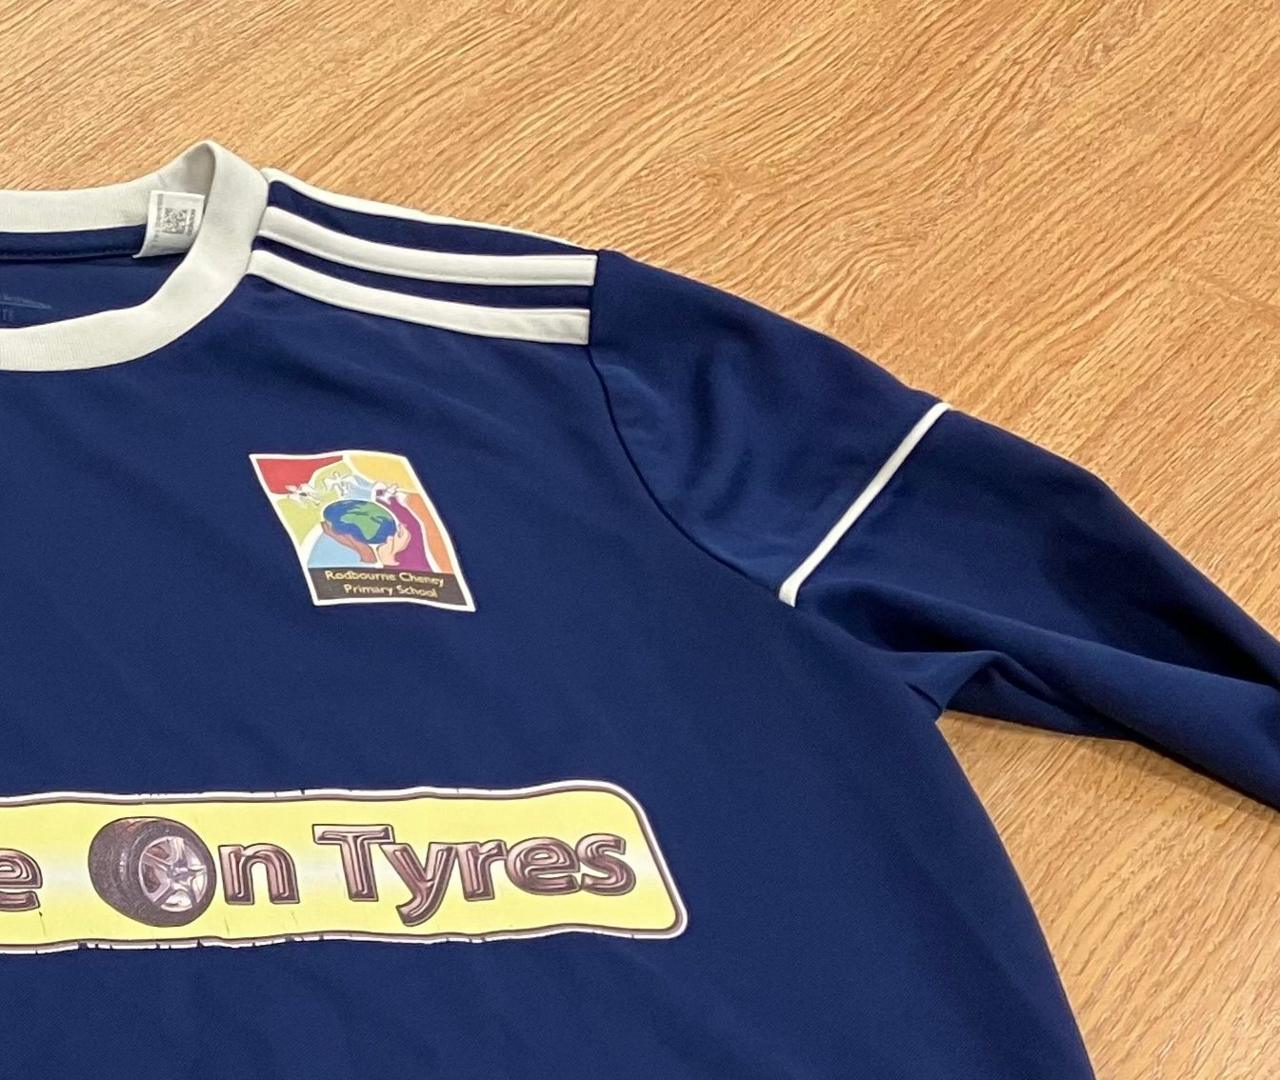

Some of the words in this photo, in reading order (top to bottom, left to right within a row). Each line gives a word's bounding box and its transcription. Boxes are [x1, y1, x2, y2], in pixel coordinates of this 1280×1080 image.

[324, 570, 396, 581] Rodbourne
[399, 572, 444, 588] Cheney
[344, 584, 393, 596] Primary
[396, 585, 438, 598] School
[312, 822, 637, 927] Tyres
